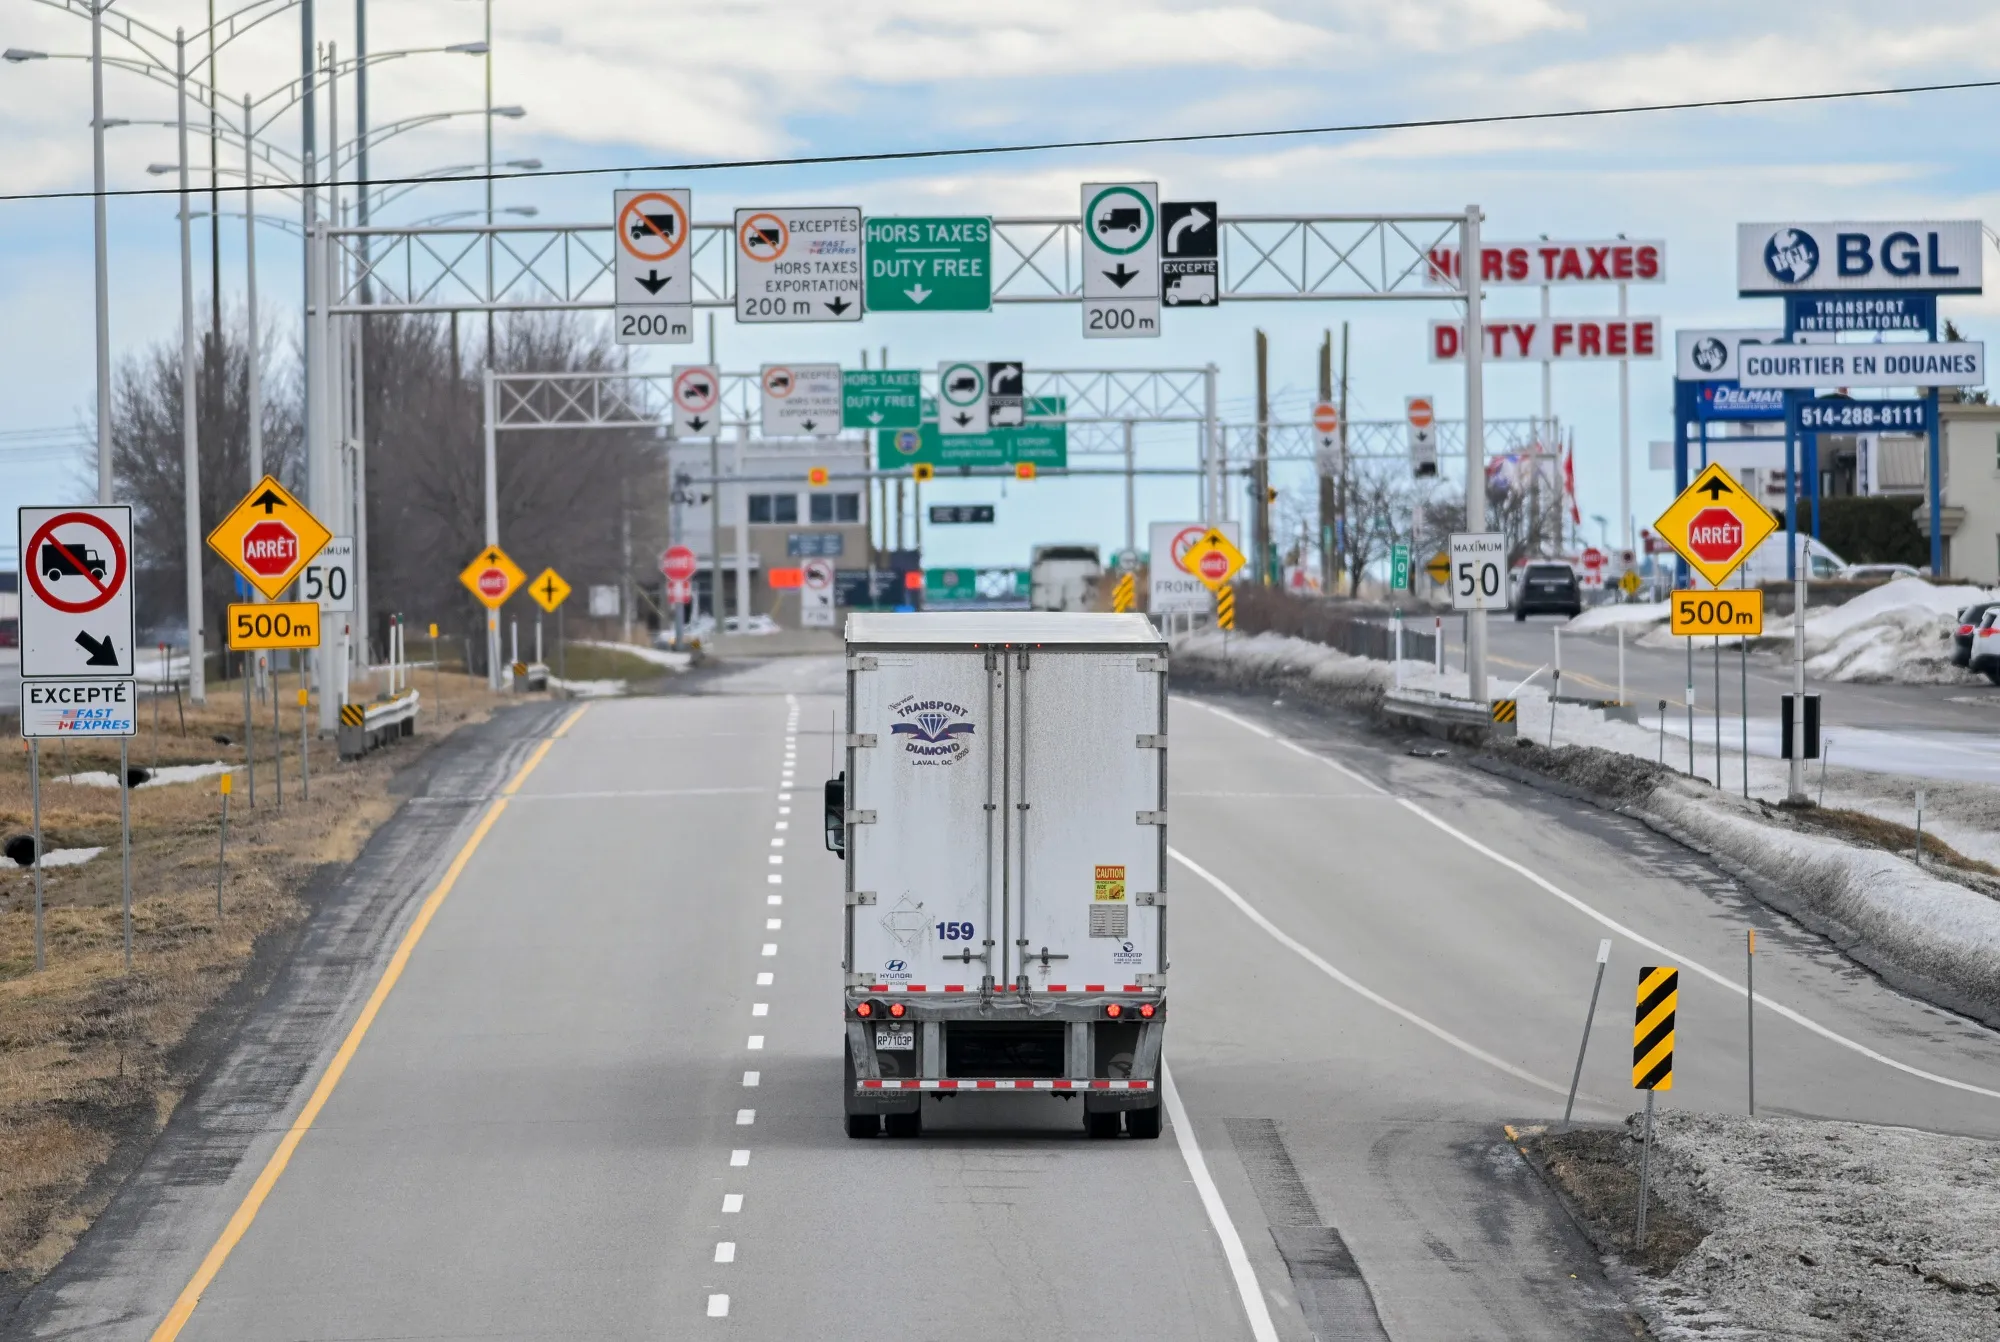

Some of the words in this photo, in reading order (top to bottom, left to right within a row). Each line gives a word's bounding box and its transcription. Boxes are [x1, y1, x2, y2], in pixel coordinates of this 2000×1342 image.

[789, 216, 857, 232] EXCEPTÉS
[867, 224, 920, 243] HORS
[927, 223, 988, 242] TAXES
[1770, 240, 1814, 273] BGL
[1836, 230, 1960, 278] BGL
[774, 262, 811, 274] HORS
[815, 261, 858, 274] TAXES
[873, 260, 925, 278] DUTY
[932, 259, 983, 278] FREE
[1163, 261, 1216, 273] EXCEPTÉ
[1428, 247, 1529, 282] HRS
[1538, 245, 1659, 281] TAXES
[765, 280, 859, 292] EXPORTATION
[745, 298, 787, 316] 200
[792, 301, 810, 315] m
[1815, 300, 1904, 315] TRANSPORT
[1799, 314, 1920, 330] INTERNATIONAL
[1434, 323, 1537, 359] DTY
[1552, 321, 1654, 356] FREE
[1746, 356, 1844, 376] COURTIER
[1852, 356, 1876, 374] EN
[1883, 354, 1976, 374] DOUANES
[844, 373, 876, 386] HORS
[881, 372, 919, 386] TAXES
[846, 396, 880, 408] DUTY
[884, 395, 916, 407] FREE
[1801, 406, 1924, 427] 514-288-8111
[1691, 523, 1740, 545] ARRÊT
[246, 536, 295, 559] ARRÊT
[319, 546, 351, 555] IMUM
[1453, 543, 1502, 553] MAXIMUM
[305, 566, 347, 600] 50
[1458, 562, 1499, 597] 50
[31, 681, 126, 703] EXCEPTÉ
[76, 708, 114, 719] FAST
[897, 700, 969, 718] TRANSPORT
[72, 719, 131, 731] EXPRES
[905, 742, 960, 756] DIAMOND
[1096, 867, 1124, 879] CAUTION
[935, 921, 975, 941] 159
